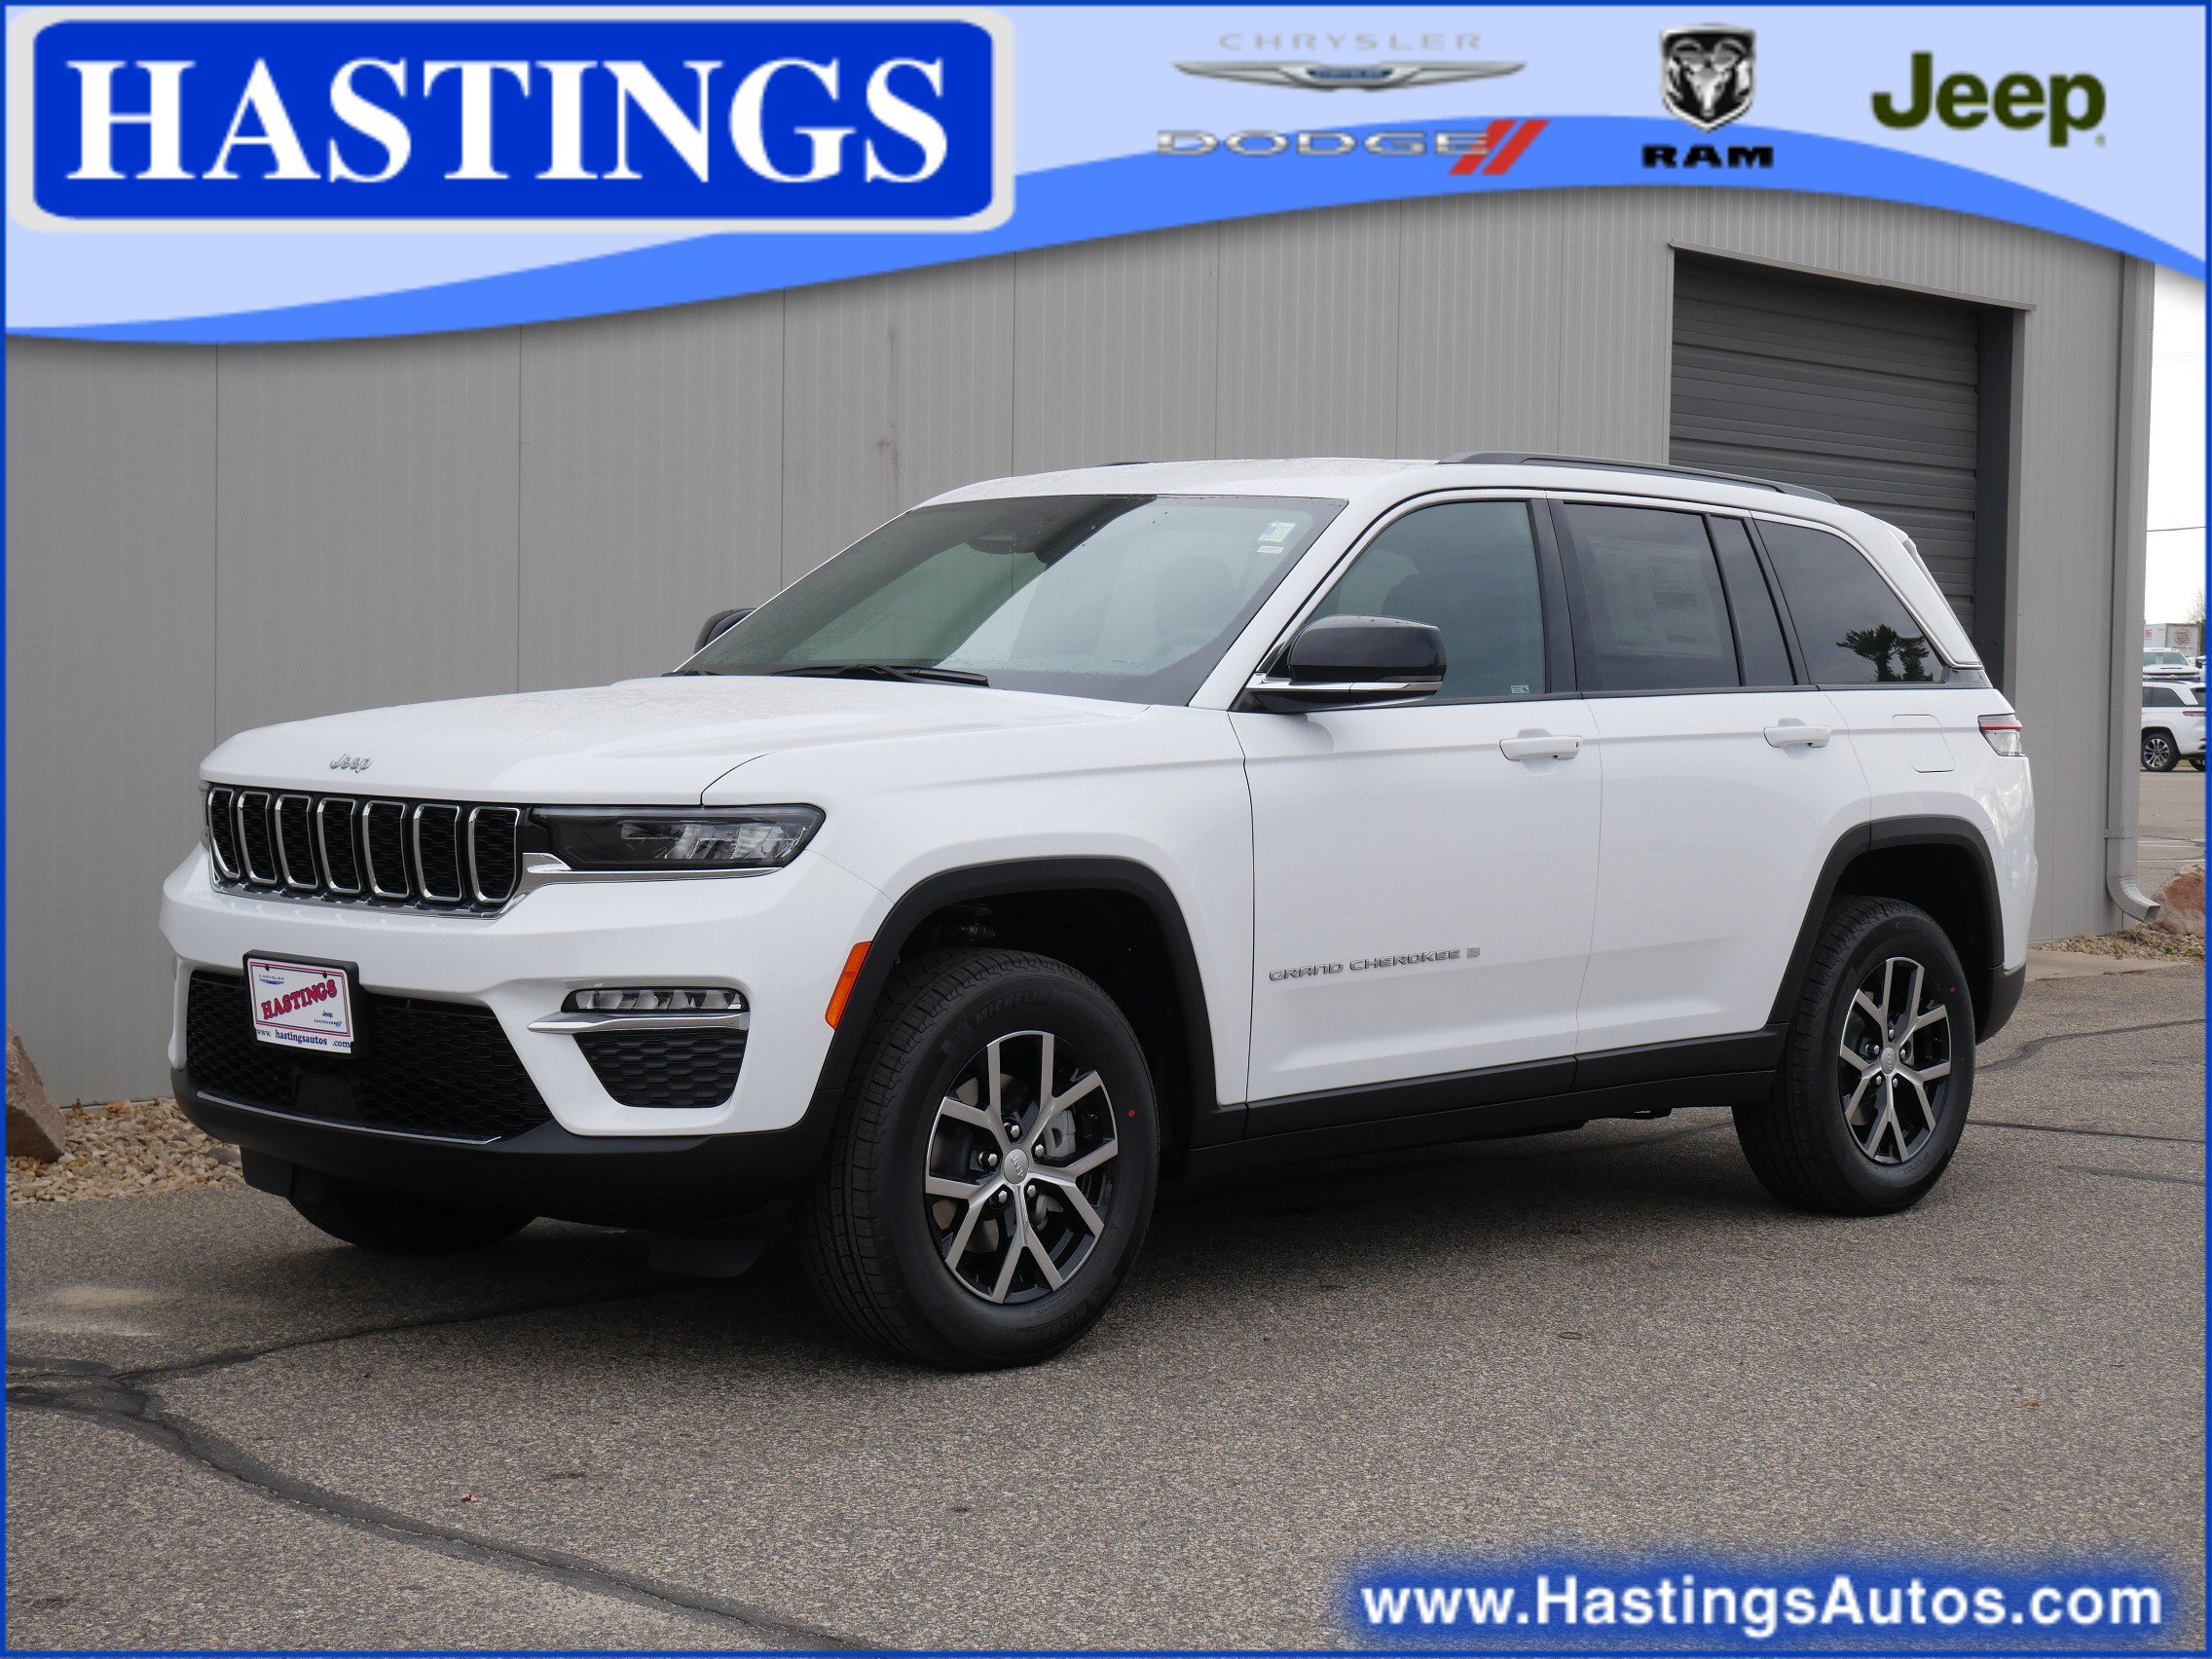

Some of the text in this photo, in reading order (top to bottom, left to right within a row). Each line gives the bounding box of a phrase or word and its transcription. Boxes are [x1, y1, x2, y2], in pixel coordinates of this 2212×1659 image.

[329, 752, 374, 774] Jeep
[1269, 962, 1345, 981] GRAND
[1349, 947, 1461, 972] CHEROKEE
[260, 978, 338, 1020] HASTINGS
[275, 1029, 328, 1046] hastingsautos
